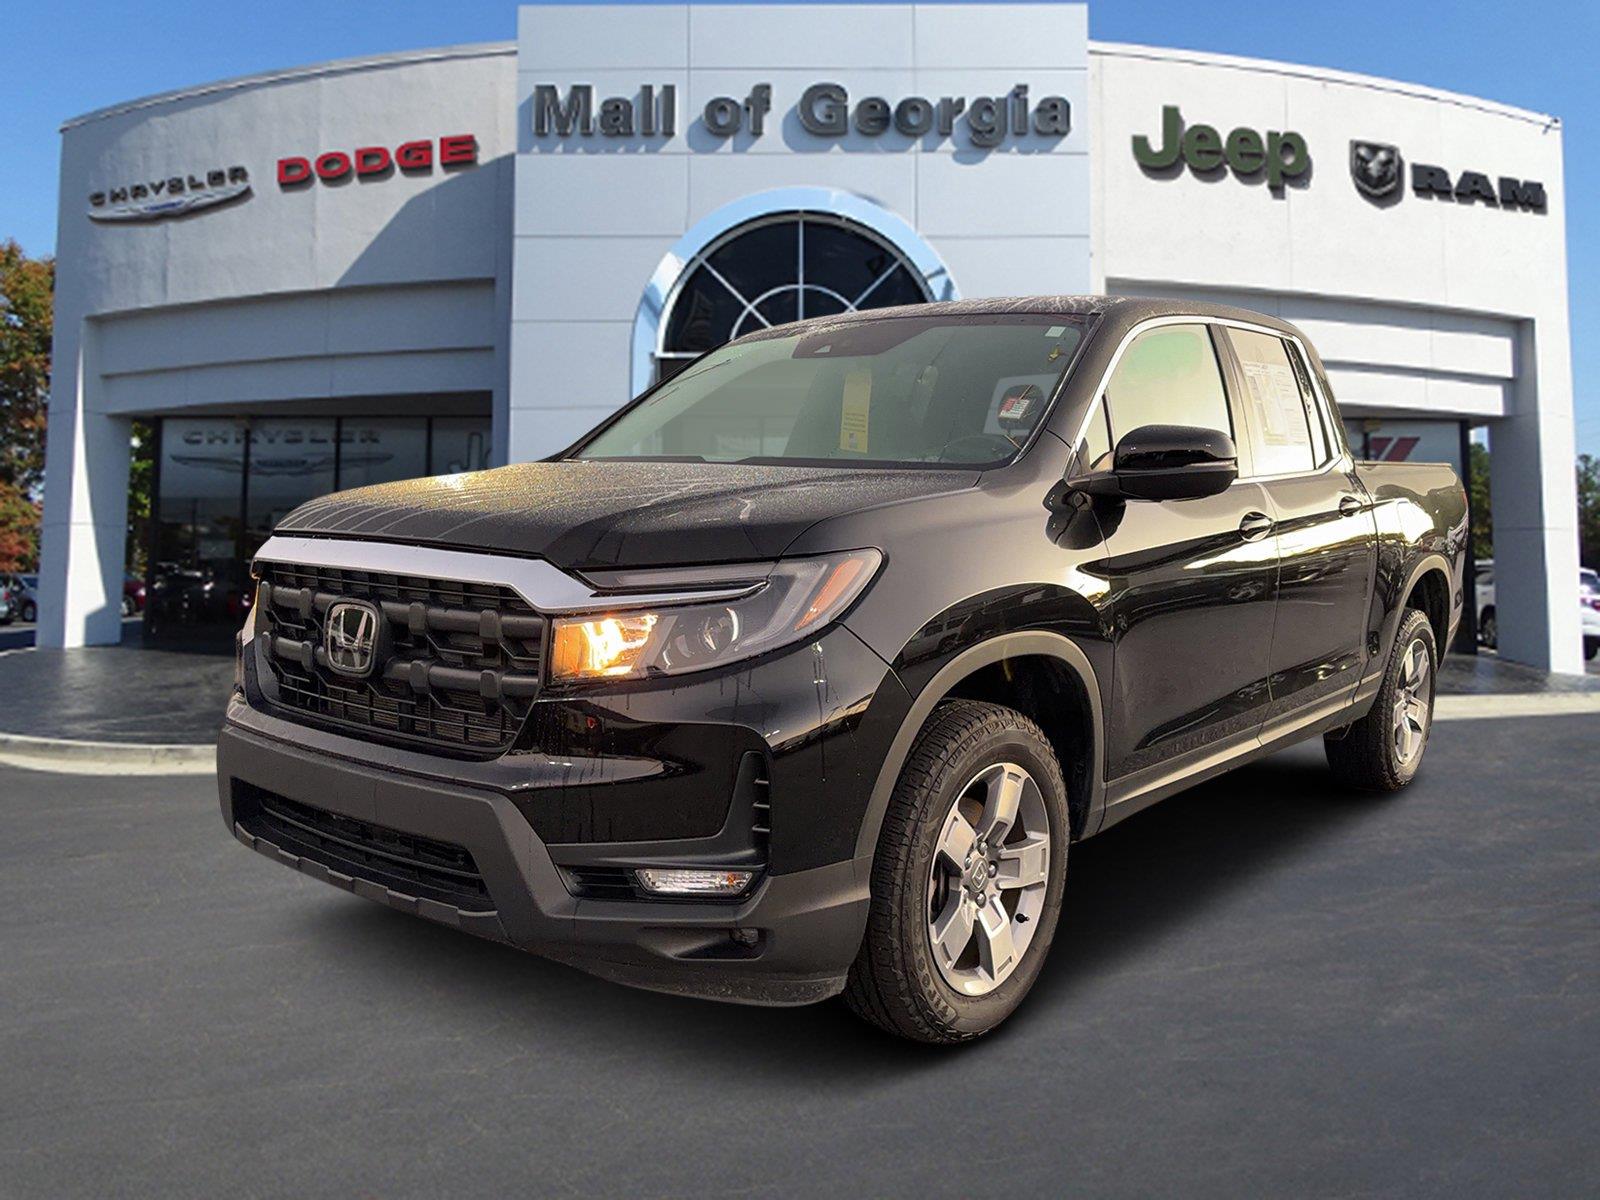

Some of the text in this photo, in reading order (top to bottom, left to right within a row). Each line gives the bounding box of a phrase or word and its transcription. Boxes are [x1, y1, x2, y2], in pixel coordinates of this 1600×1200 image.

[533, 83, 1072, 147] Mall of Georgia
[276, 134, 477, 188] DODGE
[1131, 105, 1311, 193] Jeep
[89, 166, 249, 207] CHRYSLER
[1410, 162, 1547, 212] RAM
